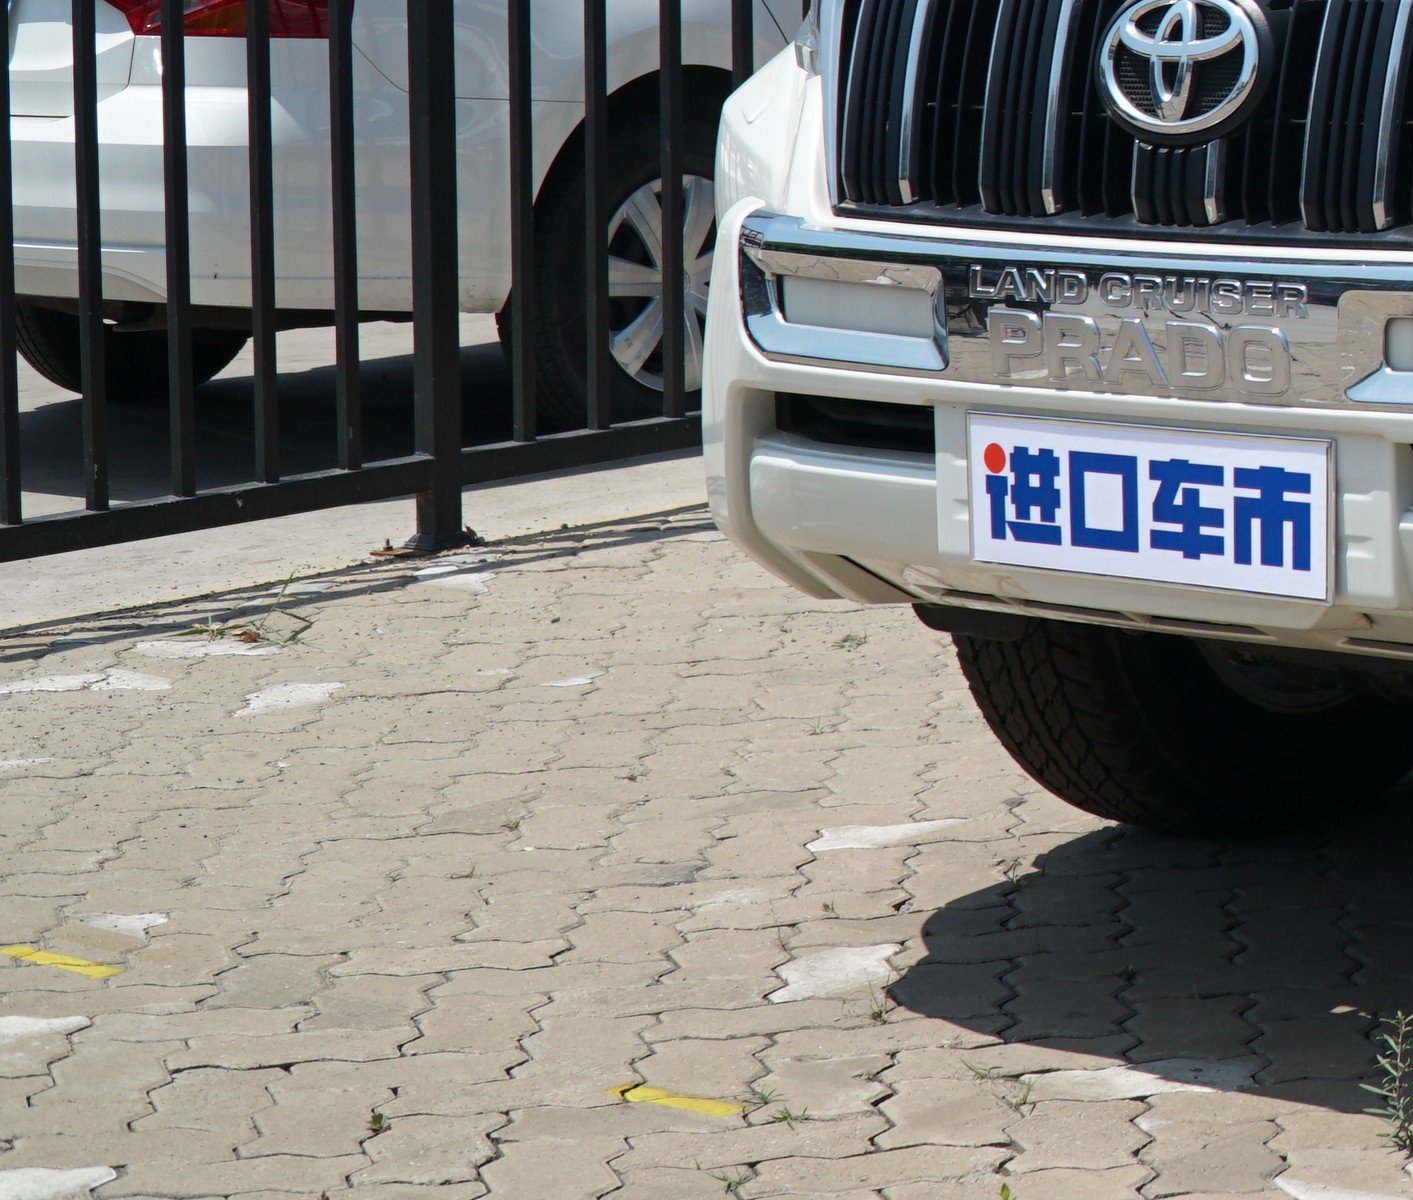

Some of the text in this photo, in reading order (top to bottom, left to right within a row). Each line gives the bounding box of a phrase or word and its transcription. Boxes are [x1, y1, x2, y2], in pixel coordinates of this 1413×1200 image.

[969, 263, 1310, 319] LAND CRUISER
[988, 307, 1291, 397] PRADO
[984, 442, 1311, 572] 进口车市
